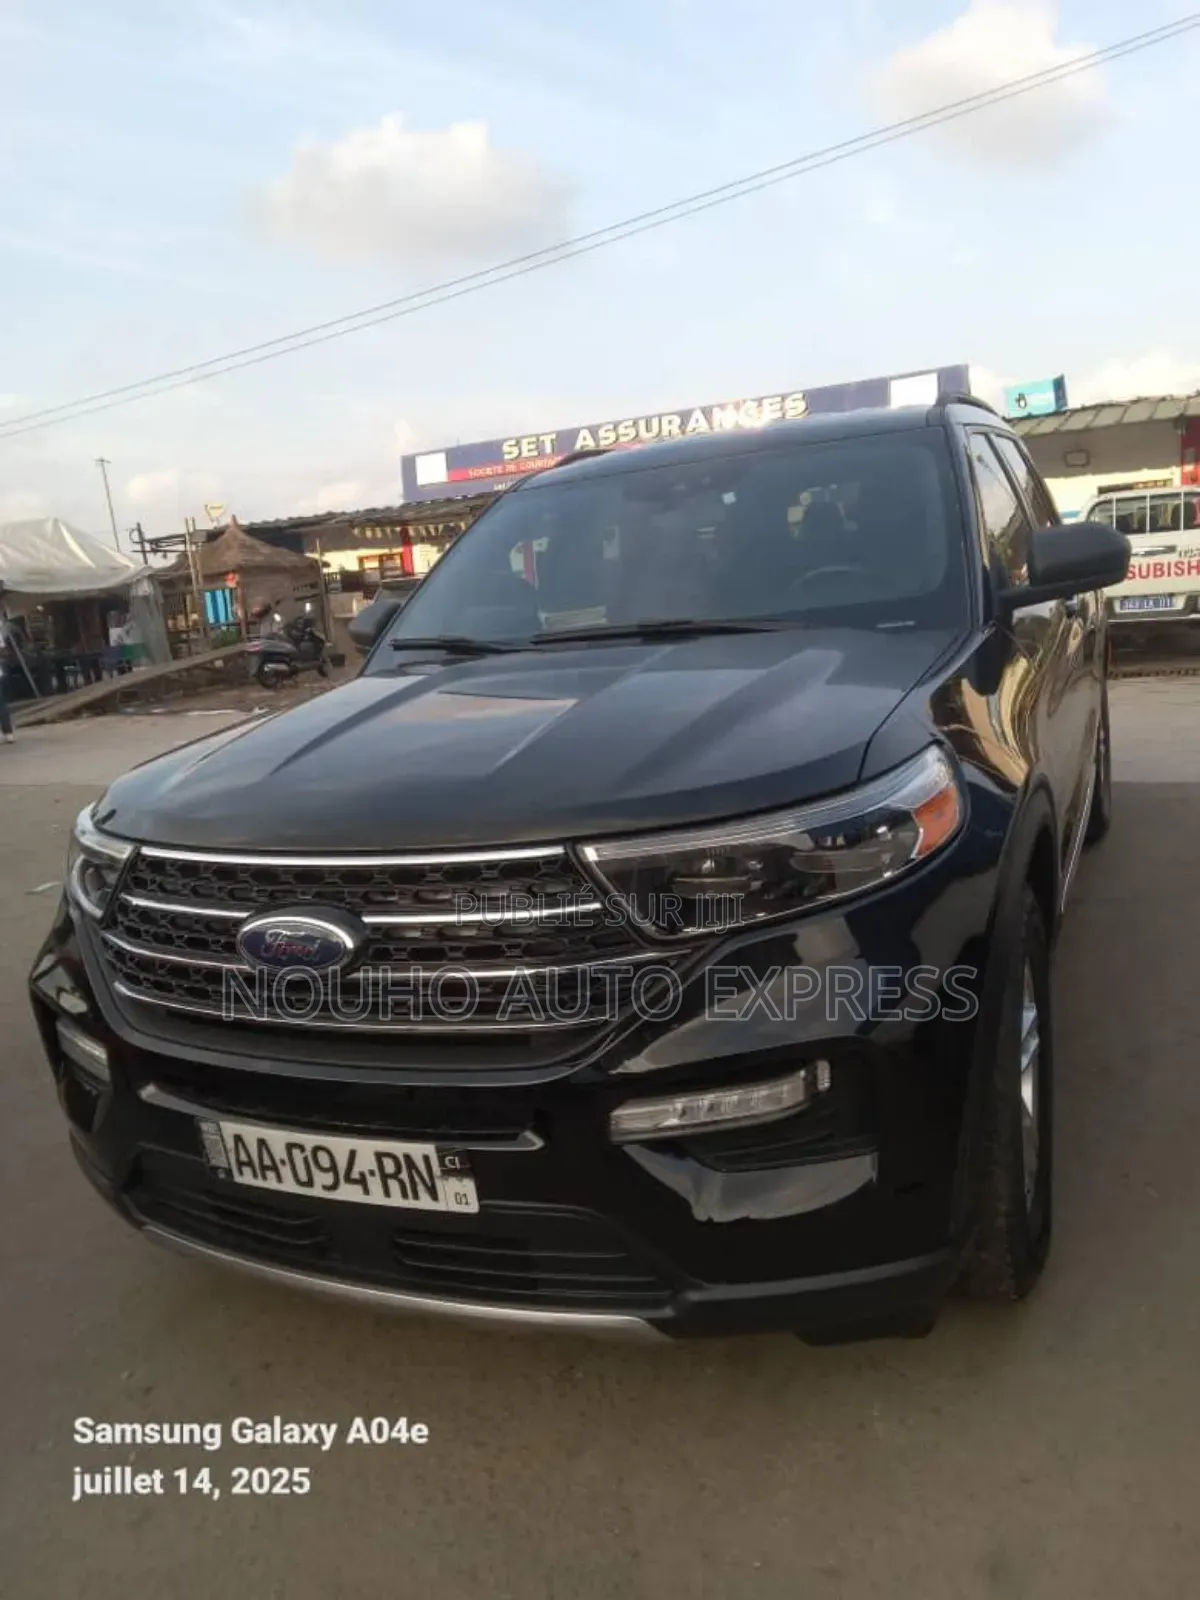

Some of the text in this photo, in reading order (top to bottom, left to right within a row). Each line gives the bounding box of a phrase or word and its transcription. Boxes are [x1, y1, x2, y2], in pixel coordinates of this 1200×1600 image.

[501, 393, 809, 460] SET ASSURANCES
[260, 929, 321, 961] Ford
[454, 1192, 471, 1207] 01
